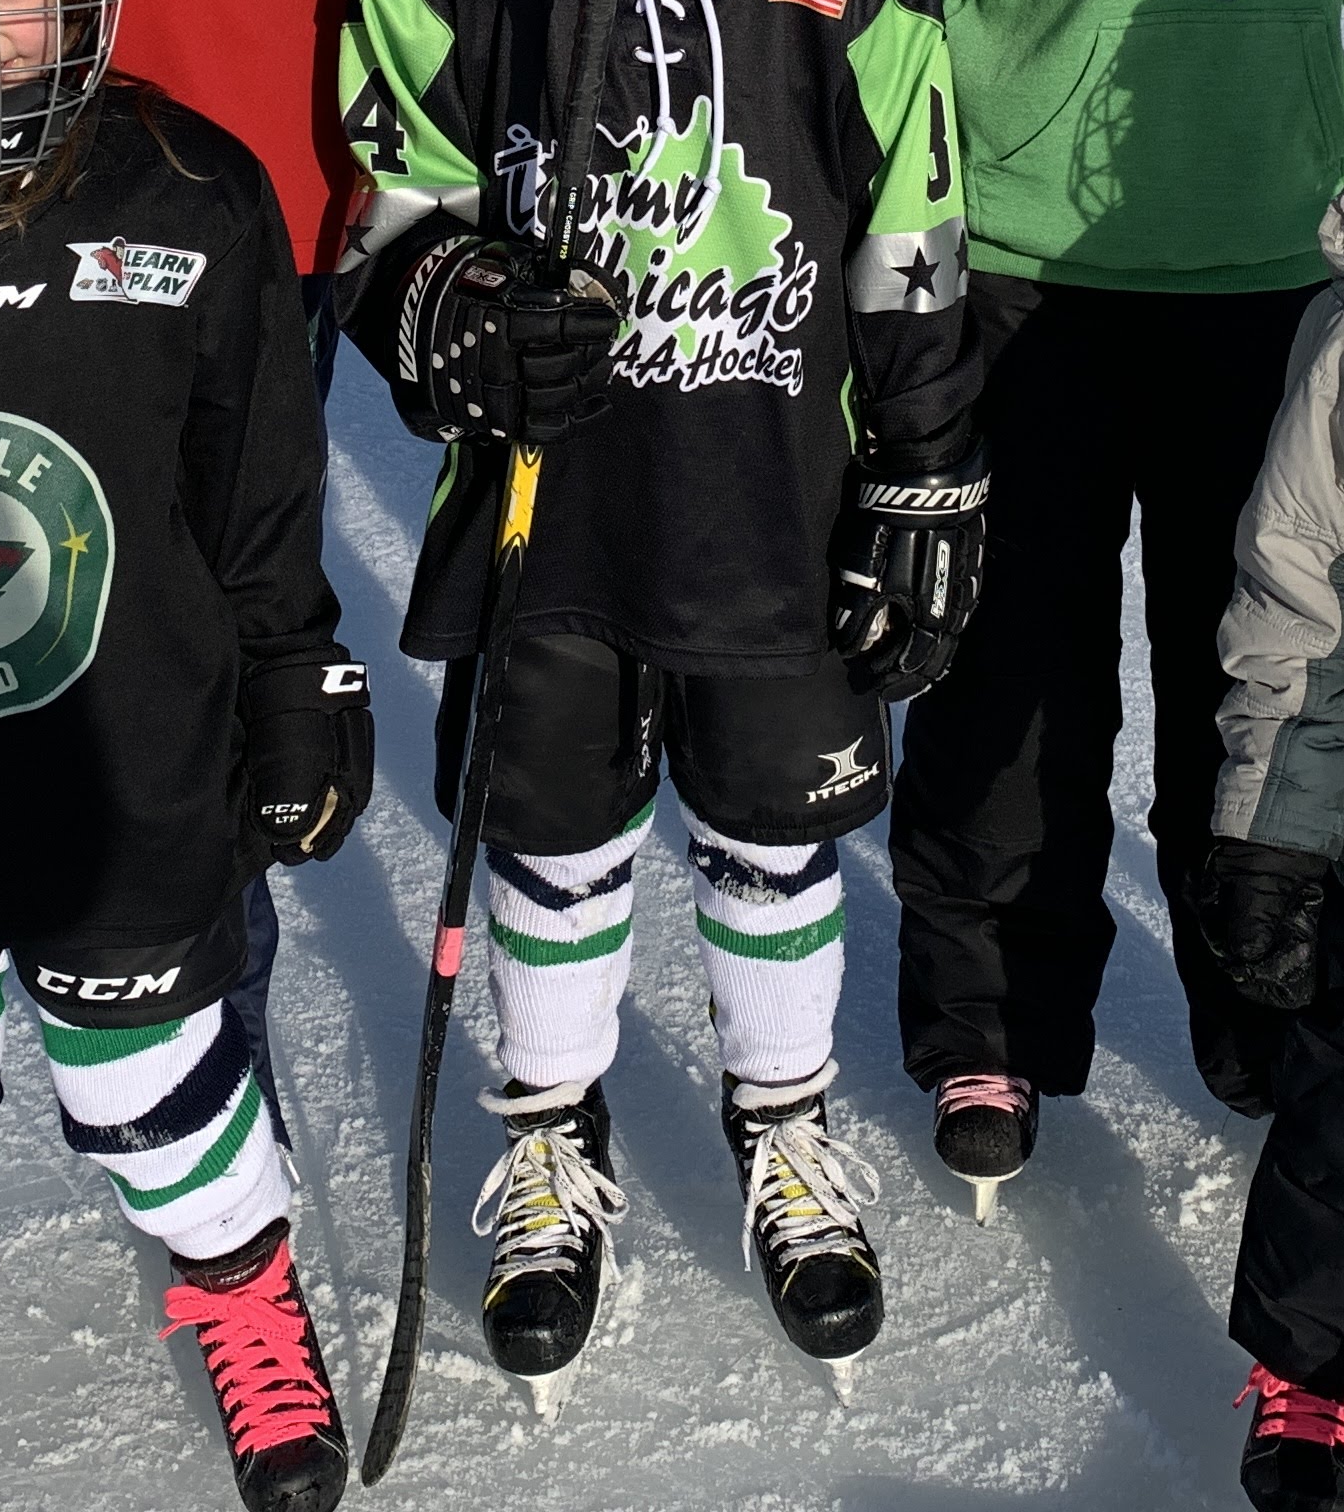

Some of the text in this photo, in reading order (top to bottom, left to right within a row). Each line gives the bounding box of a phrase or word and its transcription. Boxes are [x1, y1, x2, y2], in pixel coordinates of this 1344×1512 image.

[340, 65, 411, 177] 4
[123, 249, 197, 276] LEARN
[128, 272, 189, 296] PLAY
[588, 230, 817, 337] hicago
[682, 330, 804, 396] Hockey
[805, 759, 880, 804] ITECH
[260, 803, 309, 816] CCM
[36, 965, 182, 1001] CCM
